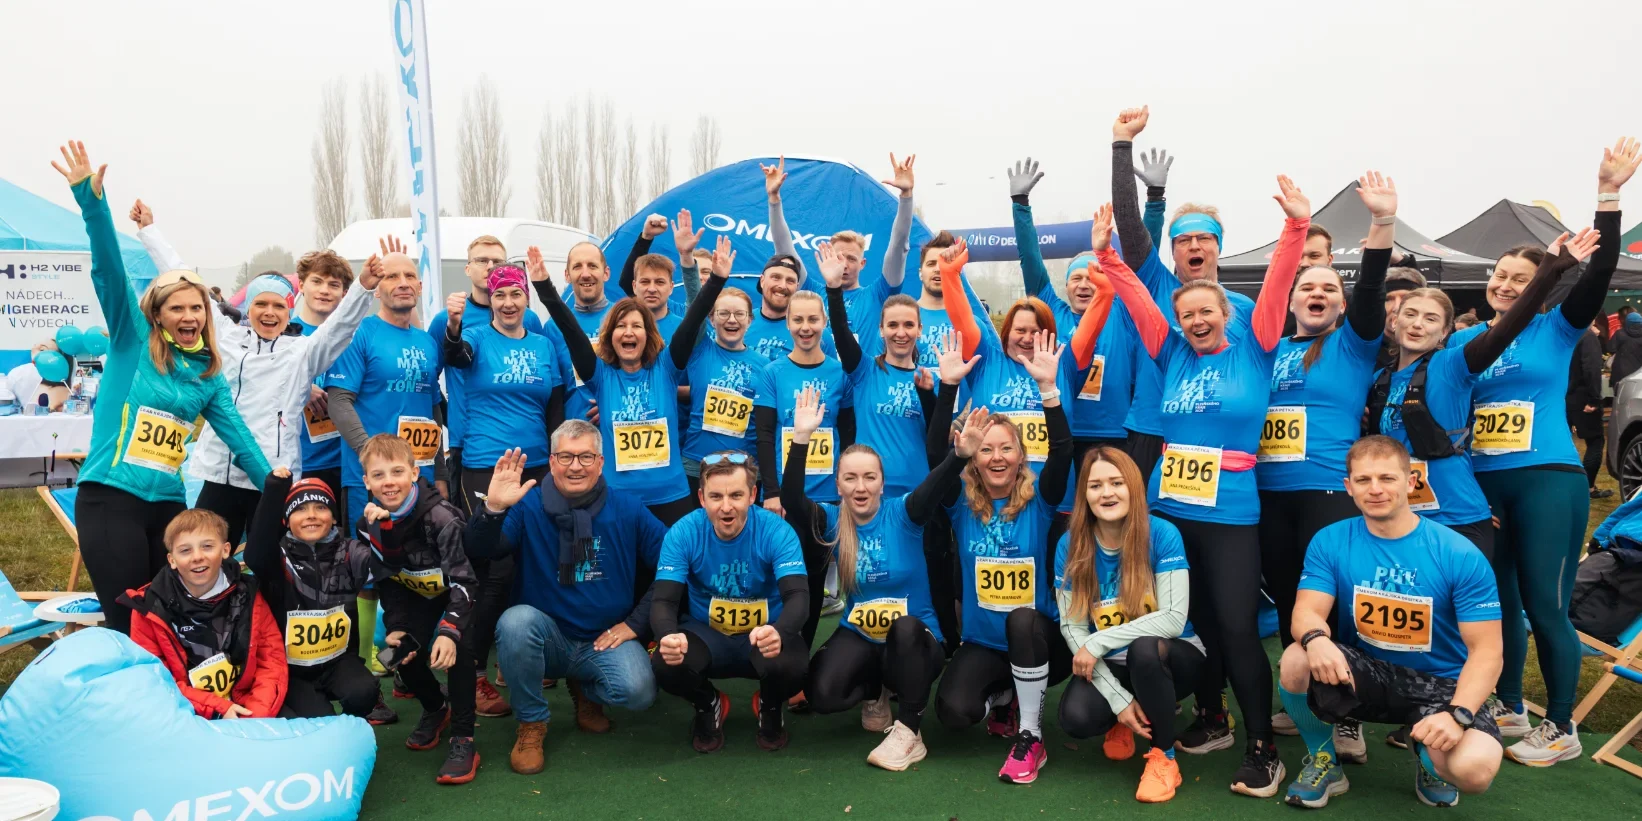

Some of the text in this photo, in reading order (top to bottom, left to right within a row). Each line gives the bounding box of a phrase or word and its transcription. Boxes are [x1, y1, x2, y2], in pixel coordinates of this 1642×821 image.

[703, 213, 873, 253] OMX
[1001, 234, 1057, 246] DECLON
[31, 264, 49, 272] H2
[52, 264, 82, 272] VIBE
[6, 288, 74, 300] NÁDECH...
[19, 317, 74, 328] VÝDECH
[402, 345, 427, 361] PŮL
[503, 356, 528, 366] MA
[510, 348, 537, 360] PŮL
[397, 357, 420, 370] MA
[512, 364, 532, 375] RA
[405, 369, 422, 381] RA
[493, 373, 526, 384] TON
[386, 379, 416, 393] TON
[896, 381, 915, 391] PŮ
[707, 396, 749, 421] 3058
[991, 393, 1027, 409] TON
[1162, 400, 1195, 414] TON
[876, 403, 906, 418] TON
[1260, 419, 1301, 441] 086
[1475, 412, 1526, 435] 3029
[137, 421, 183, 454] 3048
[402, 428, 439, 447] 2022
[1018, 422, 1049, 442] 185
[619, 430, 665, 451] 3072
[1163, 456, 1214, 482] 3196
[719, 559, 750, 576] PŮL
[1375, 564, 1416, 585] PŮL
[395, 574, 439, 591] 047
[710, 574, 738, 588] MA
[980, 569, 1030, 591] 3018
[713, 606, 762, 627] 3131
[1360, 601, 1425, 631] 2195
[292, 618, 346, 647] 3046
[199, 666, 239, 693] 304
